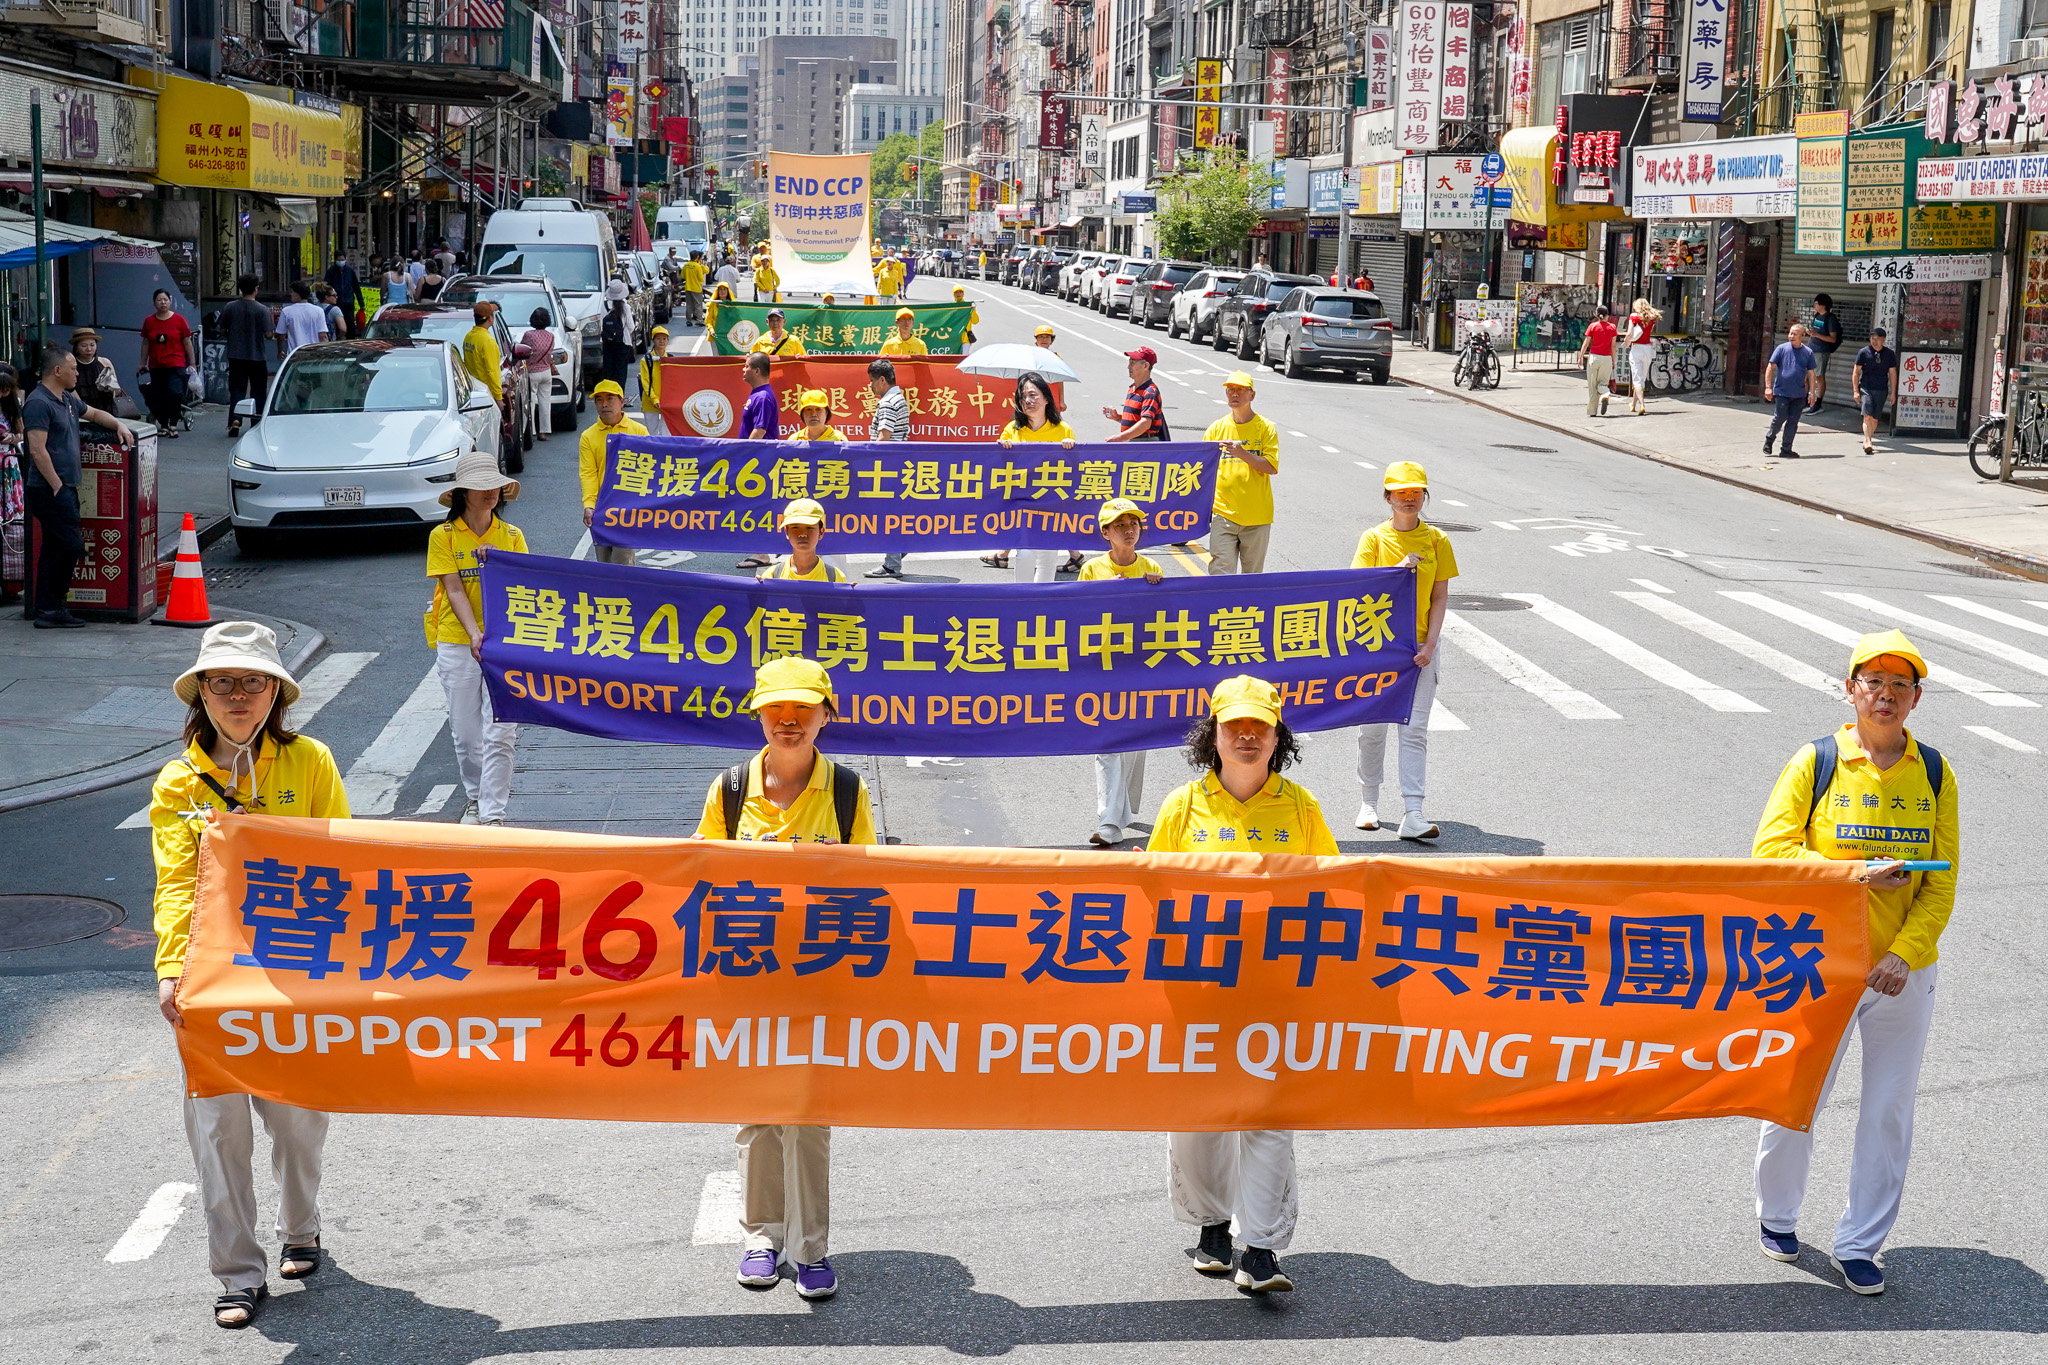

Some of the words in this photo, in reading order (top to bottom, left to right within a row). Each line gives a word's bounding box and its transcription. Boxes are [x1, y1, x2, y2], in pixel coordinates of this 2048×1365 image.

[1086, 118, 1098, 164] 大帝國
[1163, 106, 1171, 166] BINONDO
[1368, 127, 1394, 148] MoneyGra
[185, 143, 248, 158] 福州小吃店
[188, 159, 246, 171] 646-326-8810
[1454, 159, 1472, 173] 福
[1727, 155, 1768, 179] PHARMACY
[1769, 154, 1784, 177] INC
[1919, 163, 1954, 178] 212-274-8659
[1955, 161, 1977, 181] JUFU
[1980, 159, 2018, 180] GARDEN
[2019, 157, 2048, 178] RESTA
[775, 175, 819, 196] END
[824, 176, 864, 196] CCP
[1436, 176, 1454, 190] 大
[1917, 182, 1953, 197] 212-925-1637
[774, 202, 864, 220] 打倒中共惡魔
[775, 235, 801, 244] Chinese
[803, 237, 844, 245] Communist
[845, 236, 864, 244] Party
[789, 323, 953, 348] 球退黨服務中心
[972, 425, 1000, 436] THE
[81, 451, 123, 465] 到華埠
[613, 449, 1204, 503] 聲援4.6億勇士退出中共黨團隊
[604, 507, 720, 530] SUPPORT
[884, 513, 977, 535] PEOPLE
[982, 509, 1095, 534] QUITTING
[1155, 510, 1199, 530] CCP
[460, 569, 480, 577] FALU
[502, 585, 1396, 672] 聲援4.6億勇士退出中共黨團隊
[504, 670, 679, 713] SUPPORT
[929, 694, 1065, 726] PEOPLE
[1075, 687, 1211, 727] QUITTIN
[1334, 671, 1399, 701] CCP
[1834, 793, 1931, 811] 法輪大法
[1193, 827, 1290, 842] 法輪大法
[1840, 827, 1887, 840] FALUN
[1891, 829, 1928, 841] DAFA
[1836, 842, 1919, 855] www.falundafa.org
[233, 858, 1827, 1013] 聲援4.6億勇士退出中共黨團隊
[217, 1010, 542, 1063] SUPPORT
[549, 1013, 690, 1071] 464
[695, 1016, 960, 1073] MILLION
[979, 1022, 1220, 1074] PEOPLE
[1236, 1021, 1532, 1082] QUITTING
